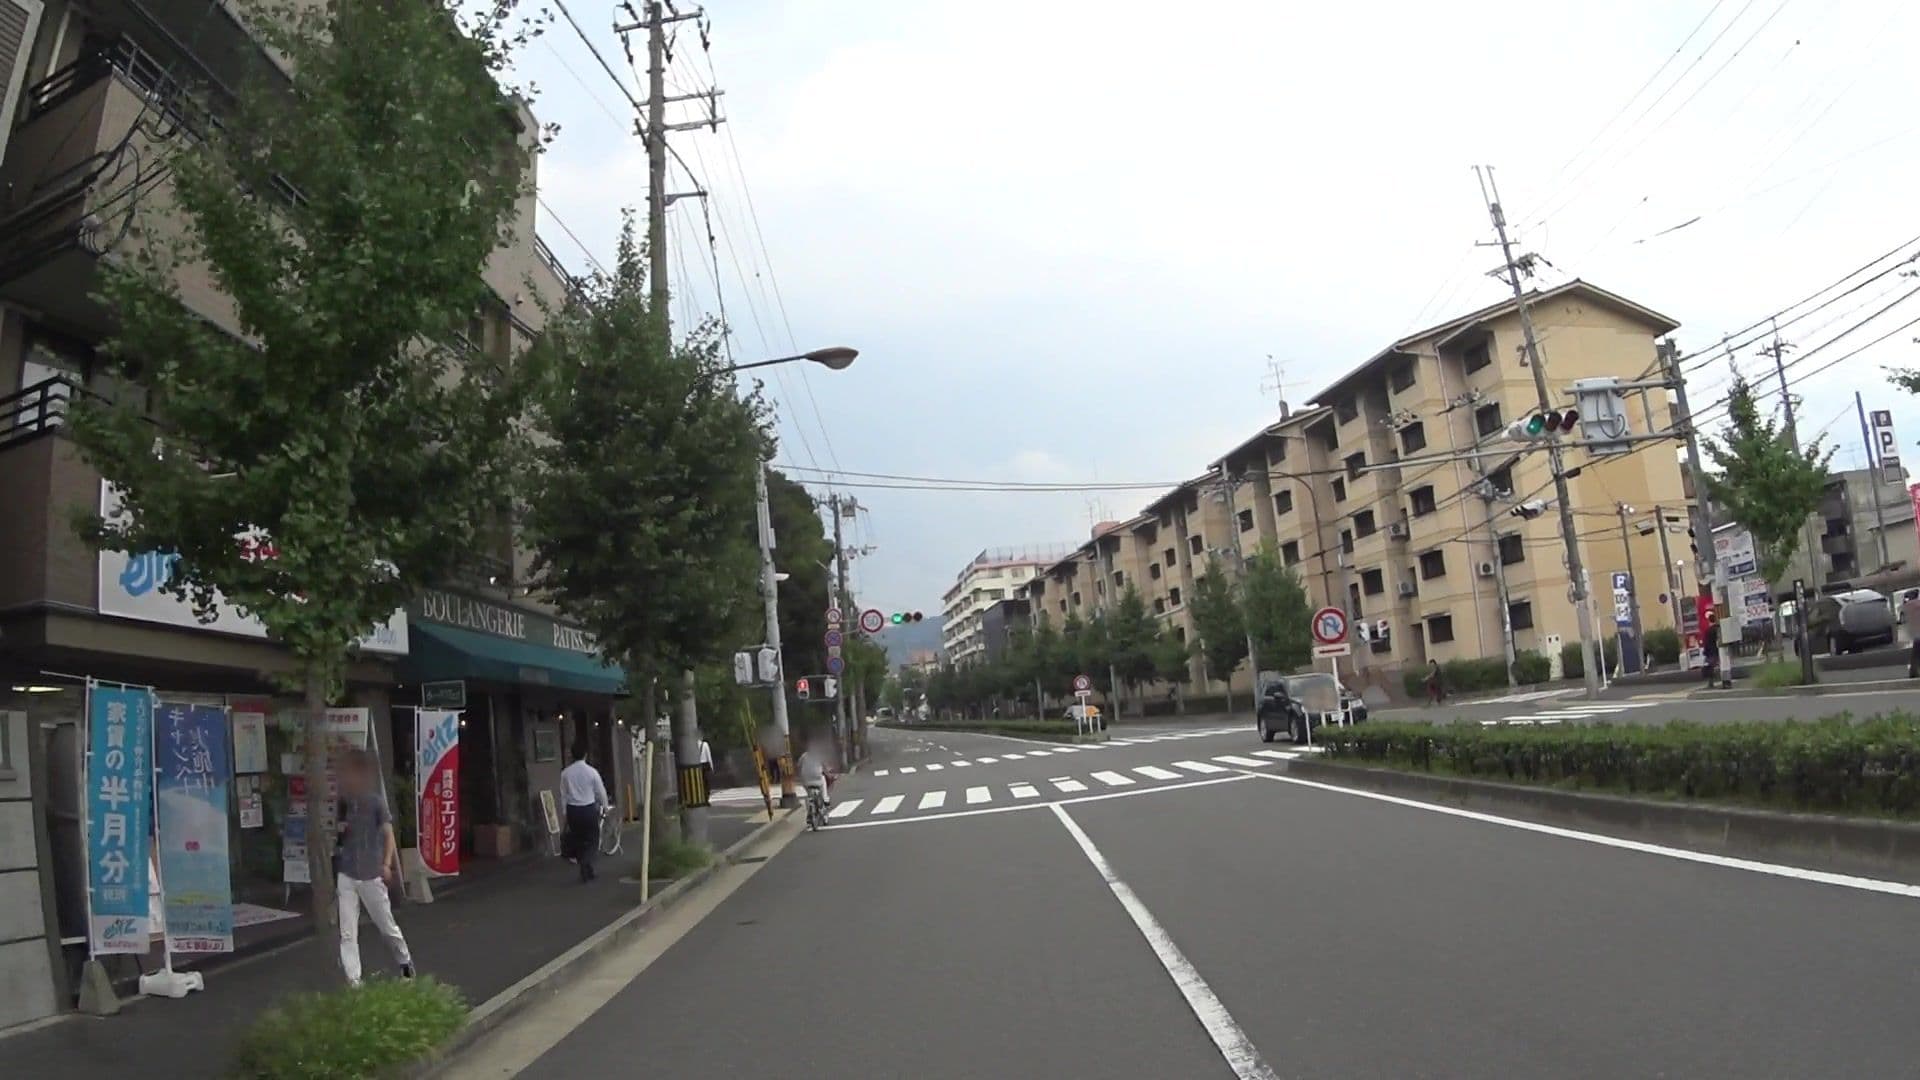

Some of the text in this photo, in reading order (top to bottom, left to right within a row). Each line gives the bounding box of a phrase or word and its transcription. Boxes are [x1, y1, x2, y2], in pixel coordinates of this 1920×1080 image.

[1516, 345, 1529, 367] 2
[1880, 431, 1893, 454] P
[1615, 575, 1626, 588] P
[423, 590, 527, 639] BOULANGERIE
